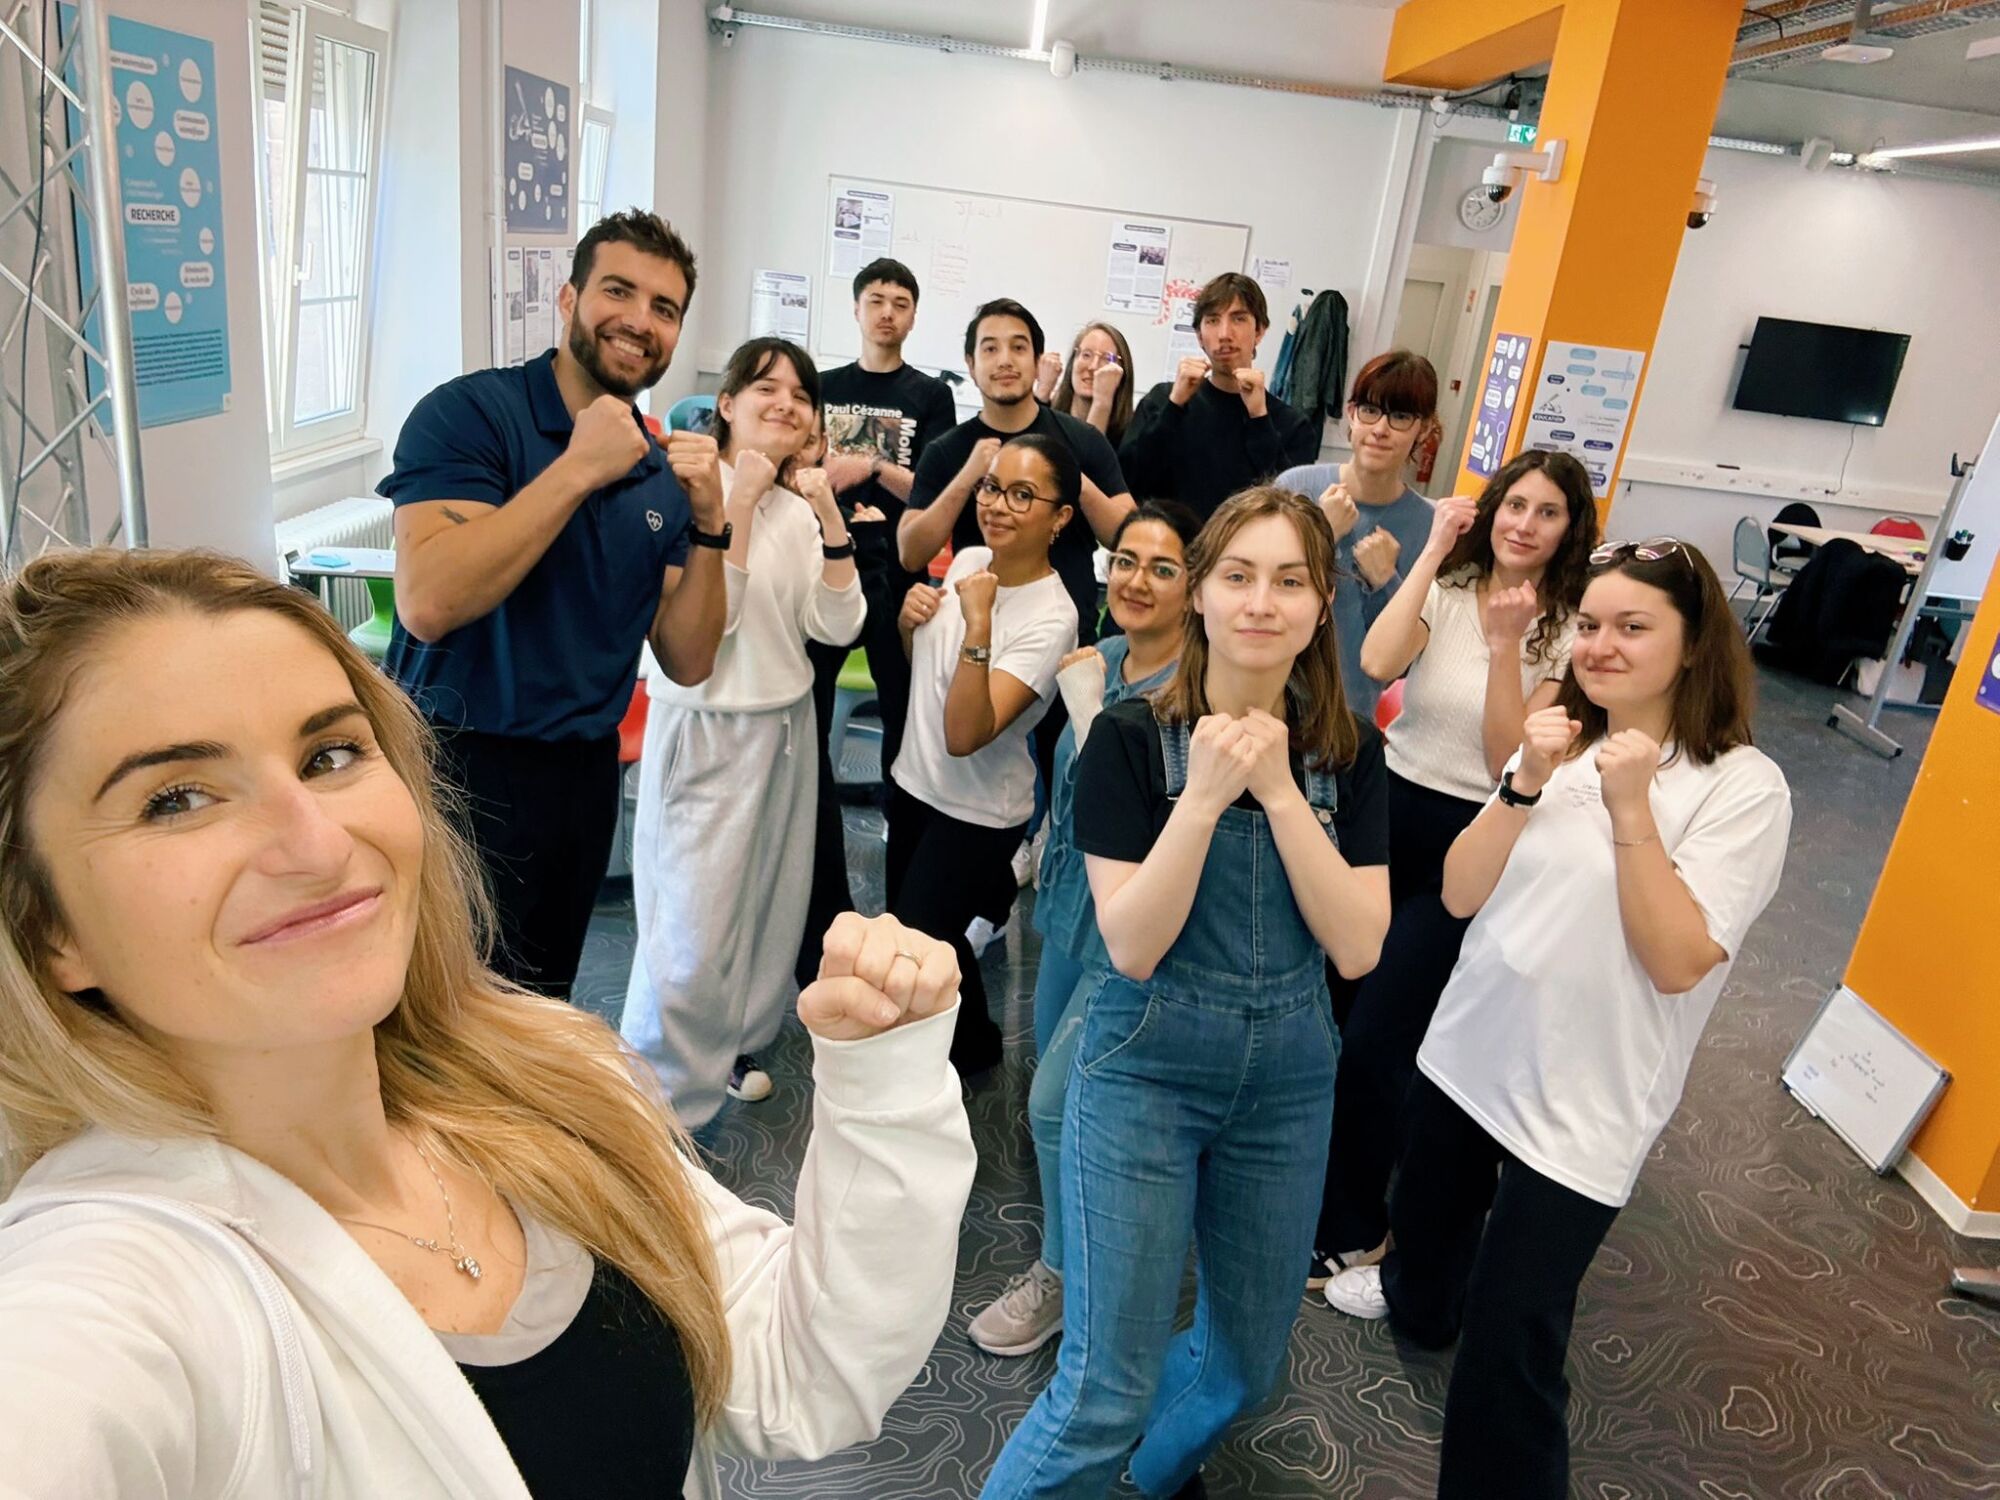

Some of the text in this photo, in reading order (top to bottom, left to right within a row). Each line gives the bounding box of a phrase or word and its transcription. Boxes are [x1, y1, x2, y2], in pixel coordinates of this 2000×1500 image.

[131, 208, 176, 221] RECHERCHE
[824, 403, 903, 419] Paul Cézanne
[897, 418, 917, 466] MoM
